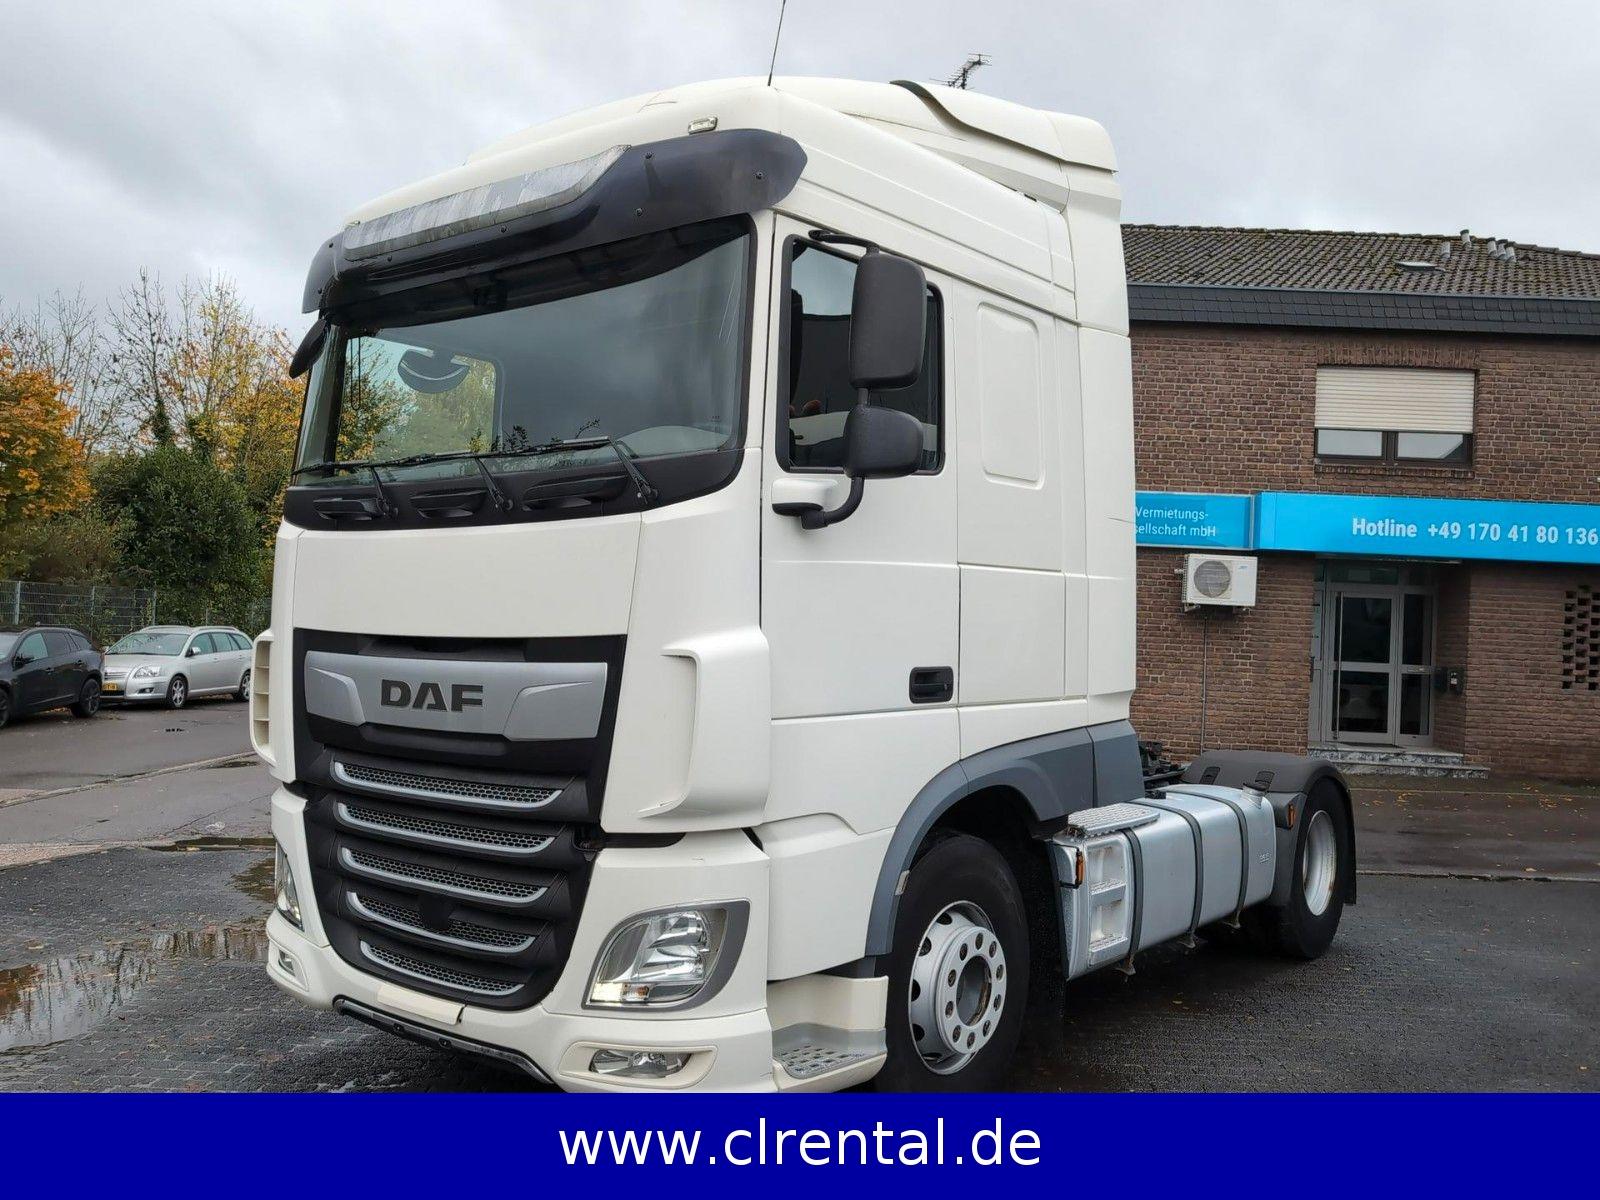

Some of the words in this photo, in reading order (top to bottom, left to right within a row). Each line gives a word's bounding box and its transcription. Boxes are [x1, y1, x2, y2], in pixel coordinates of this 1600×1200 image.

[1135, 506, 1209, 523] Vermietungs-
[1190, 525, 1217, 537] mbH
[1352, 518, 1418, 538] Hotline
[1428, 522, 1461, 539] +49
[1468, 523, 1501, 541] 170
[1508, 525, 1528, 542] 41
[1536, 526, 1559, 544] 80
[1565, 528, 1599, 545] 136
[381, 679, 484, 712] DAF
